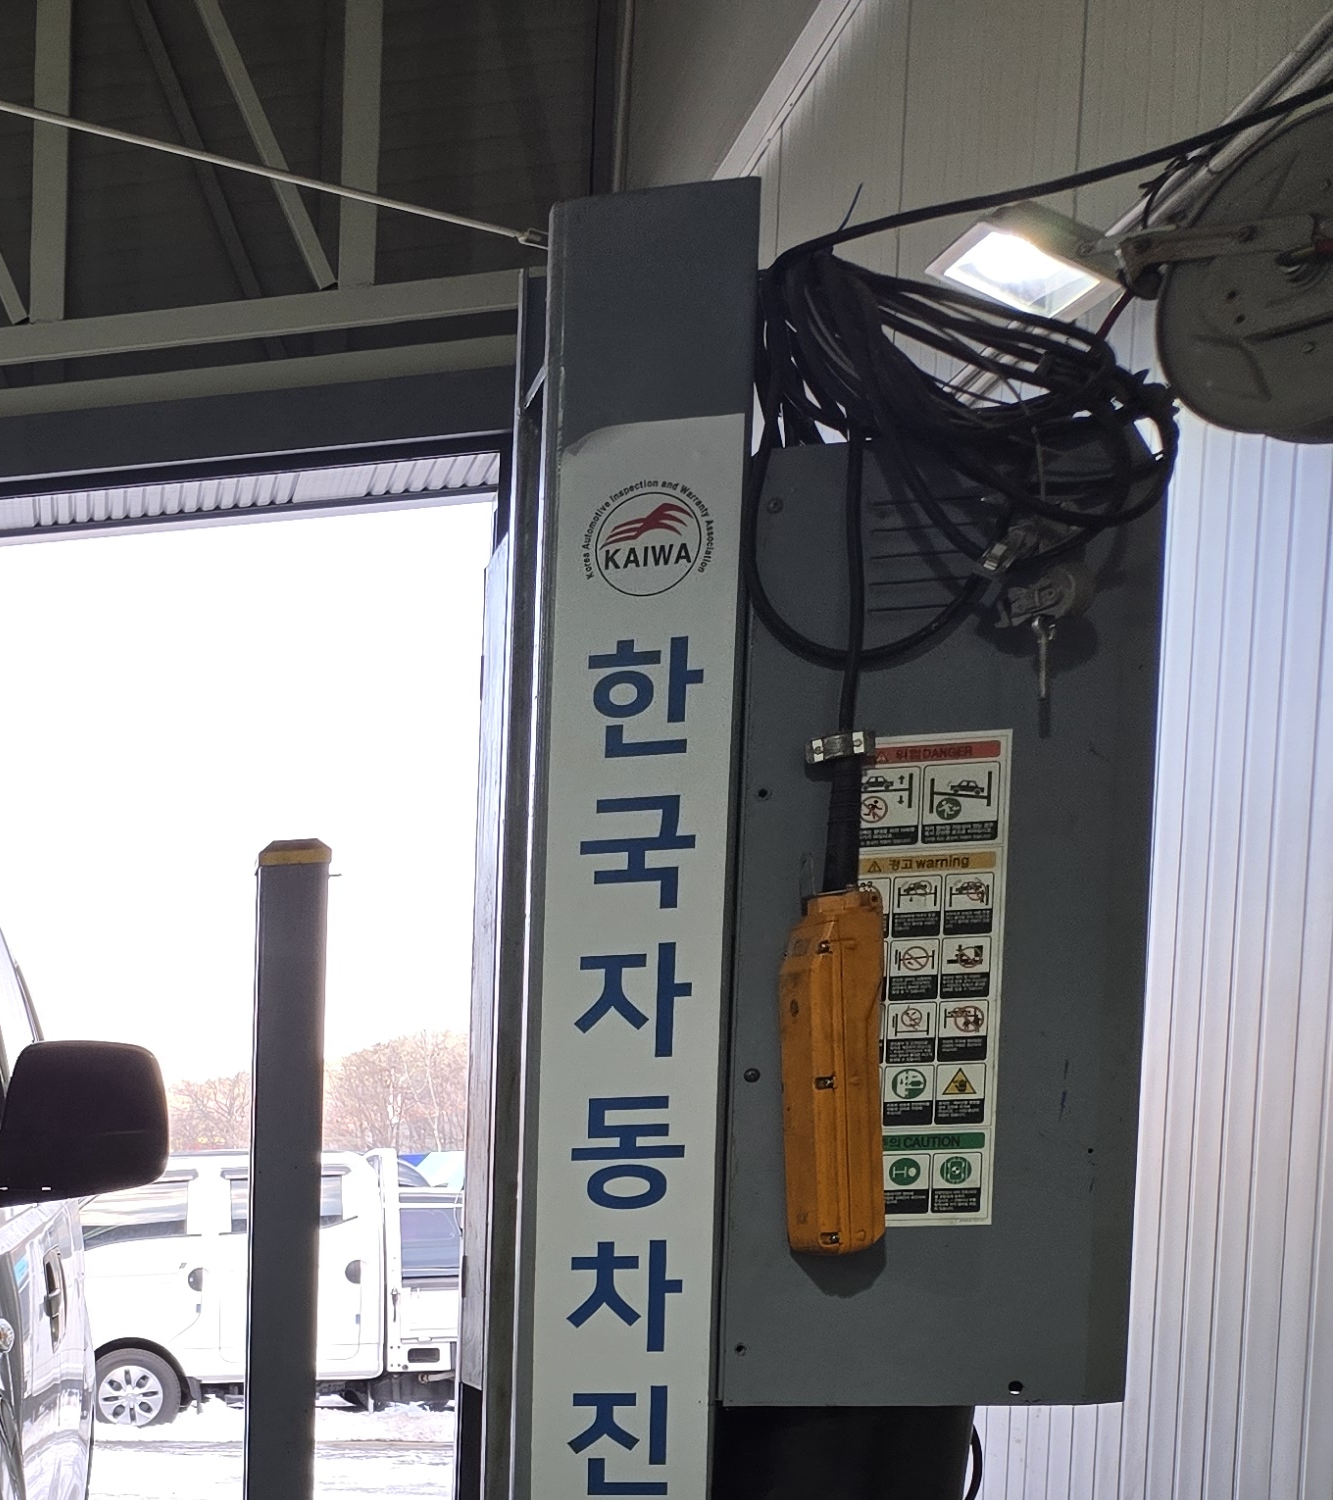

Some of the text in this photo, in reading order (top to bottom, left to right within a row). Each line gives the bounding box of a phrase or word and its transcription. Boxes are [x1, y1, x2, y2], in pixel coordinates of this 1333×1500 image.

[582, 479, 715, 580] Korea Automotive Inspection and Warranty Association
[604, 542, 692, 571] KAIWA
[923, 745, 973, 760] DANGER
[889, 854, 970, 871] 경고 warning
[903, 1135, 961, 1149] CAUTION
